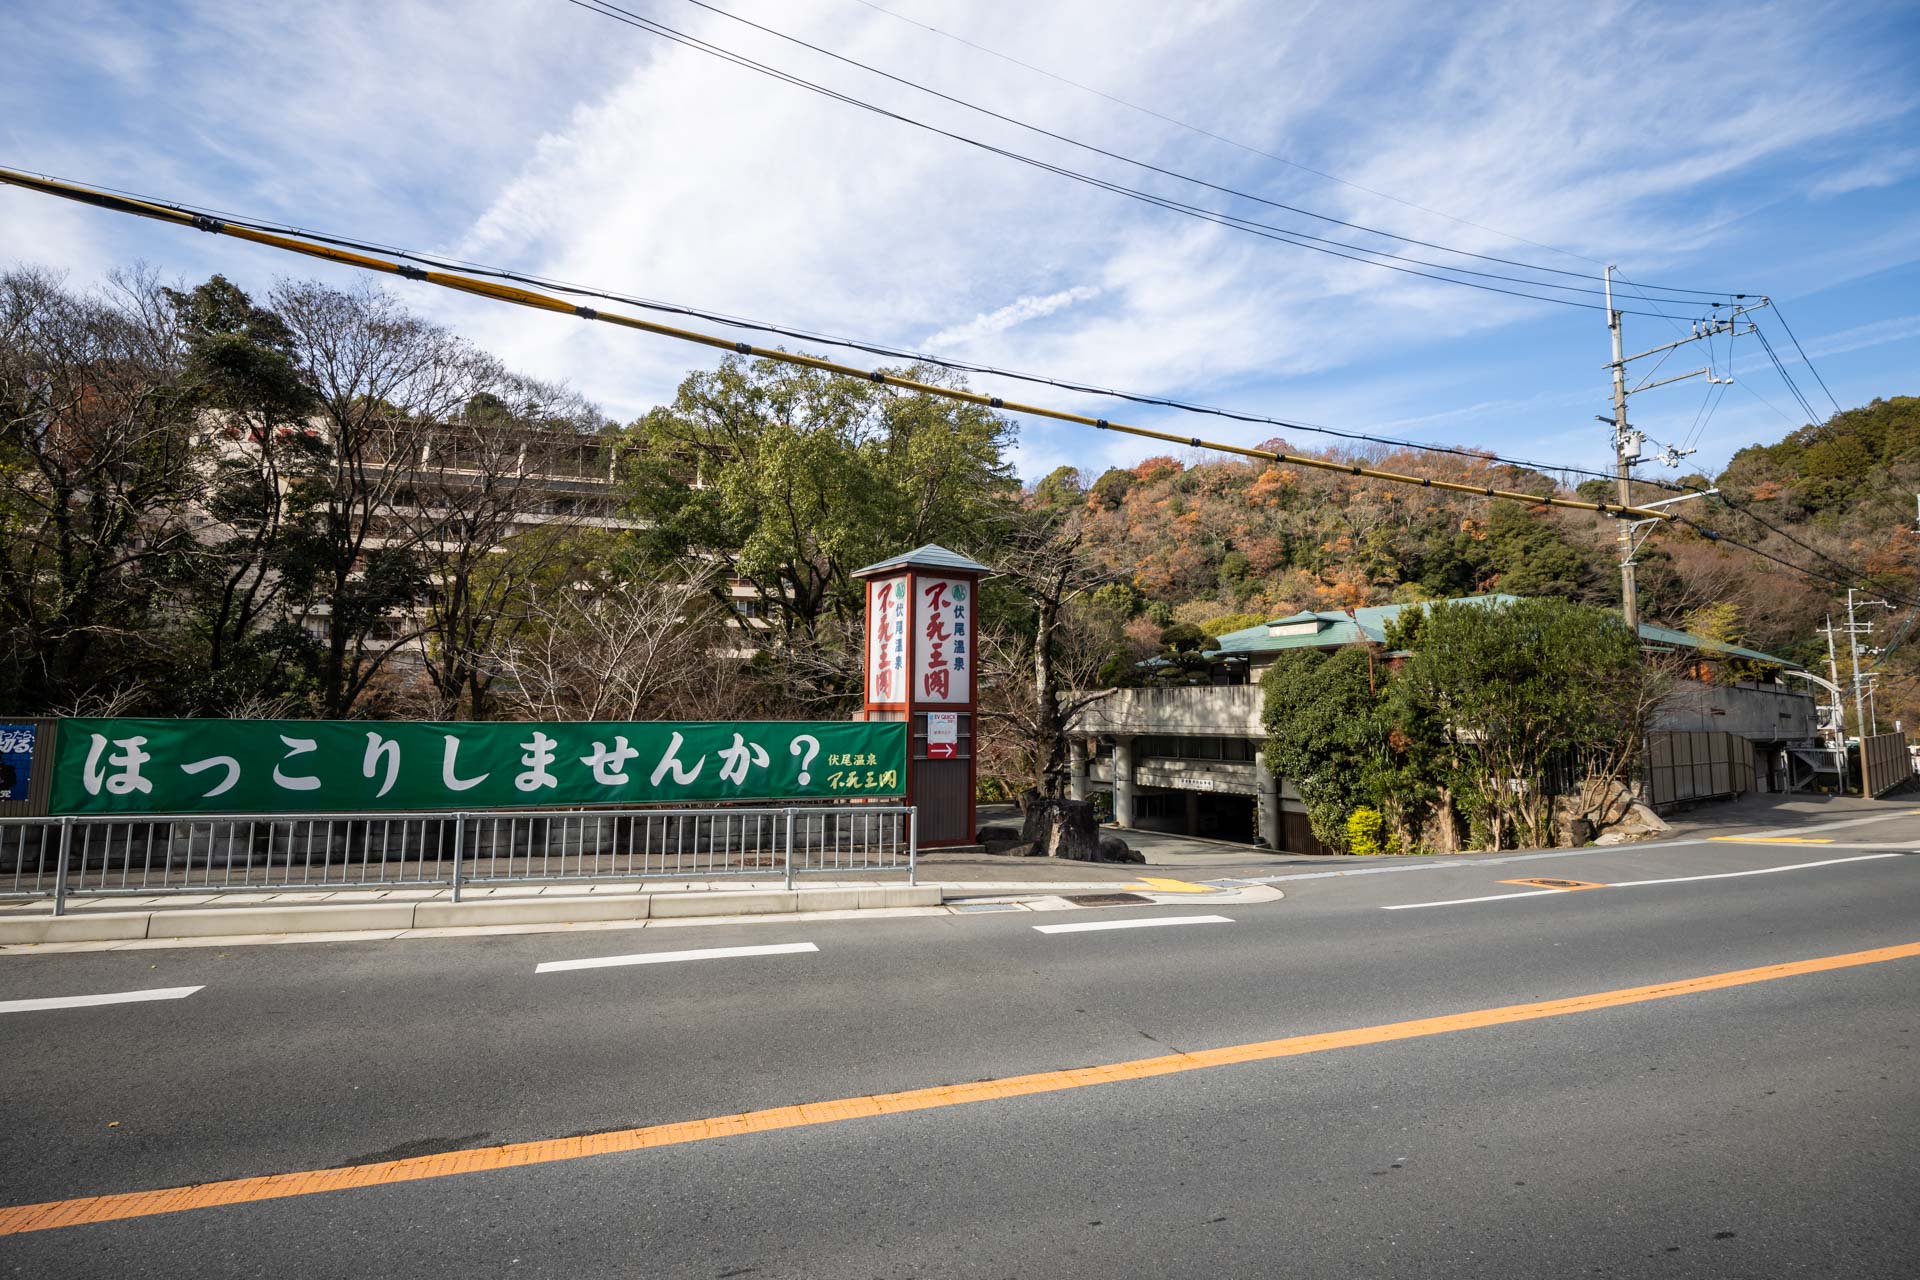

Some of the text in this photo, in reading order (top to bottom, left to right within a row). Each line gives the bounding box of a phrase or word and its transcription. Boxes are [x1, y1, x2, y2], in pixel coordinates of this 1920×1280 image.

[953, 605, 965, 671] 伏尾温泉
[828, 753, 877, 766] 伏尾温泉
